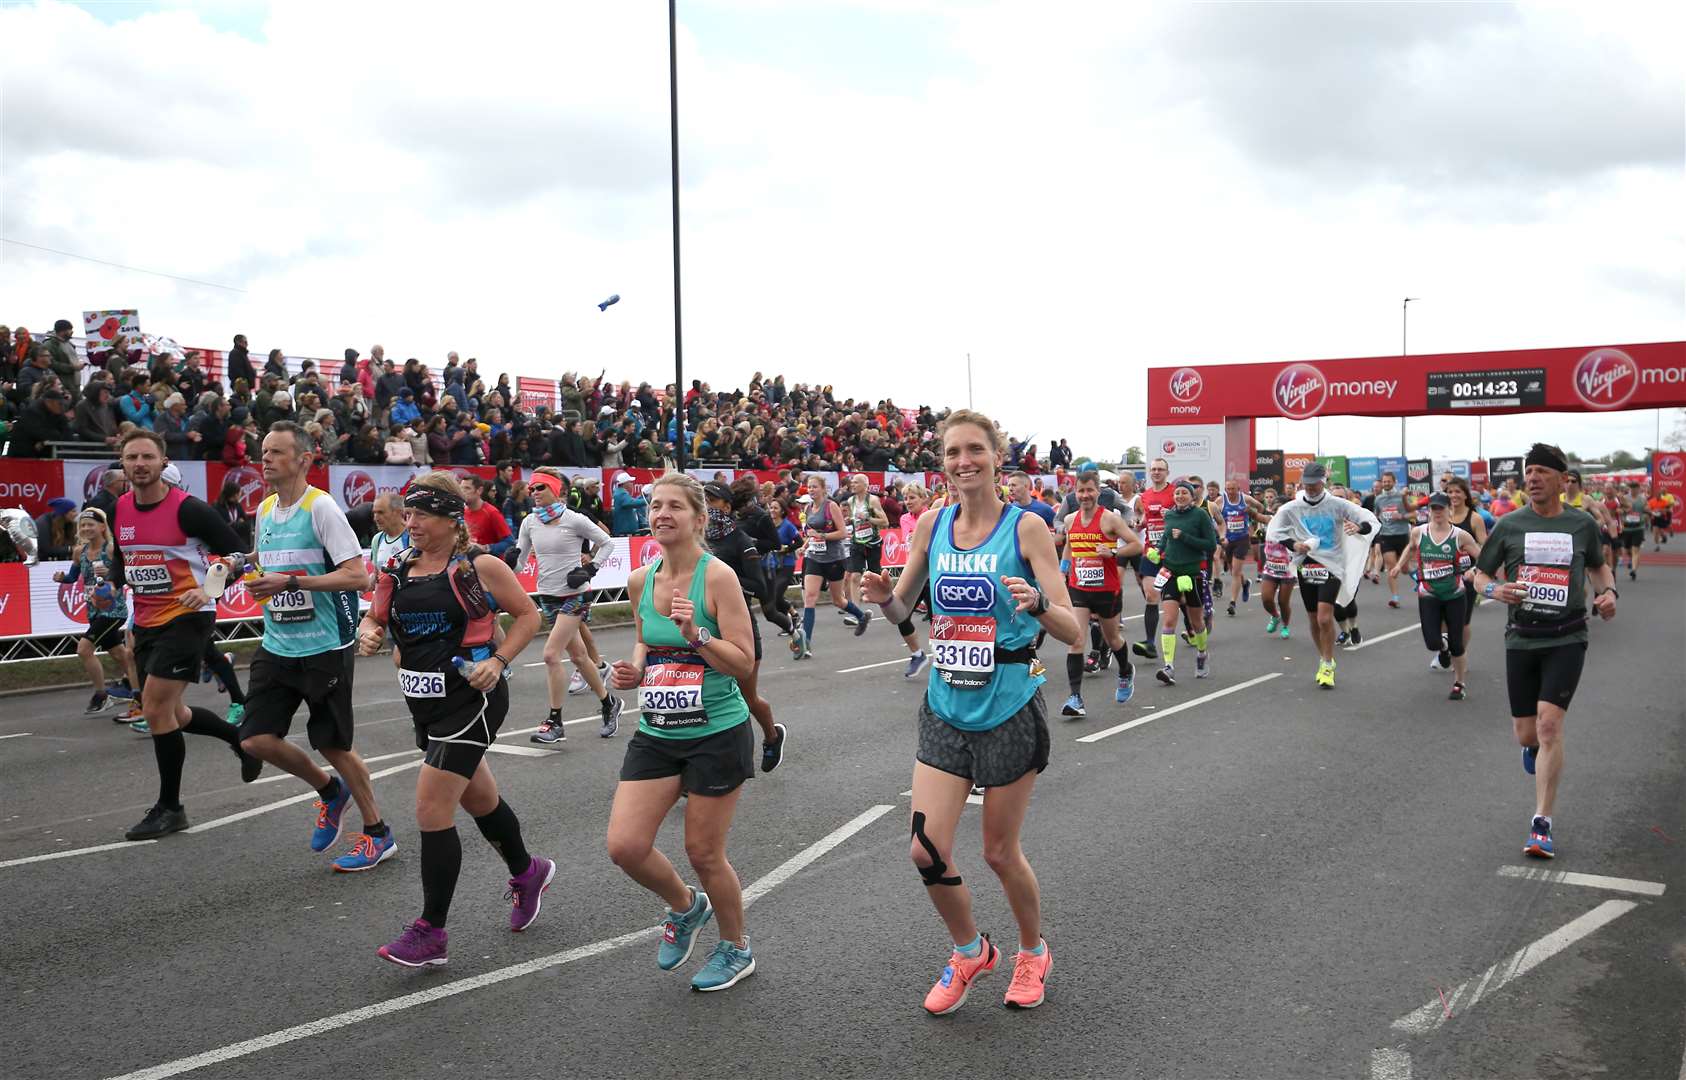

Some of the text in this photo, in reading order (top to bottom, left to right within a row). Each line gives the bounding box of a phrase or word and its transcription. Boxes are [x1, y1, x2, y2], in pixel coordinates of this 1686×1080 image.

[1172, 373, 1200, 397] Virgin
[1580, 357, 1632, 399] Virgin
[1279, 371, 1398, 409] Virgin money
[1453, 380, 1518, 397] 00:14:23
[1170, 405, 1201, 415] money
[1256, 456, 1274, 464] dible
[345, 475, 374, 507] Virgin
[1069, 533, 1103, 541] SERPENTINE
[139, 552, 162, 561] money
[265, 551, 295, 562] MATT
[936, 553, 998, 573] NIKKI
[128, 567, 168, 582] 16393
[1078, 569, 1104, 579] 12898
[1541, 571, 1568, 583] money
[272, 591, 306, 608] 8709
[941, 586, 988, 601] RSPCA
[1529, 585, 1566, 603] 0990
[932, 615, 994, 639] Virgin money
[936, 645, 992, 667] 33160
[665, 669, 702, 680] money
[400, 673, 443, 694] 33236
[644, 690, 699, 709] 32667
